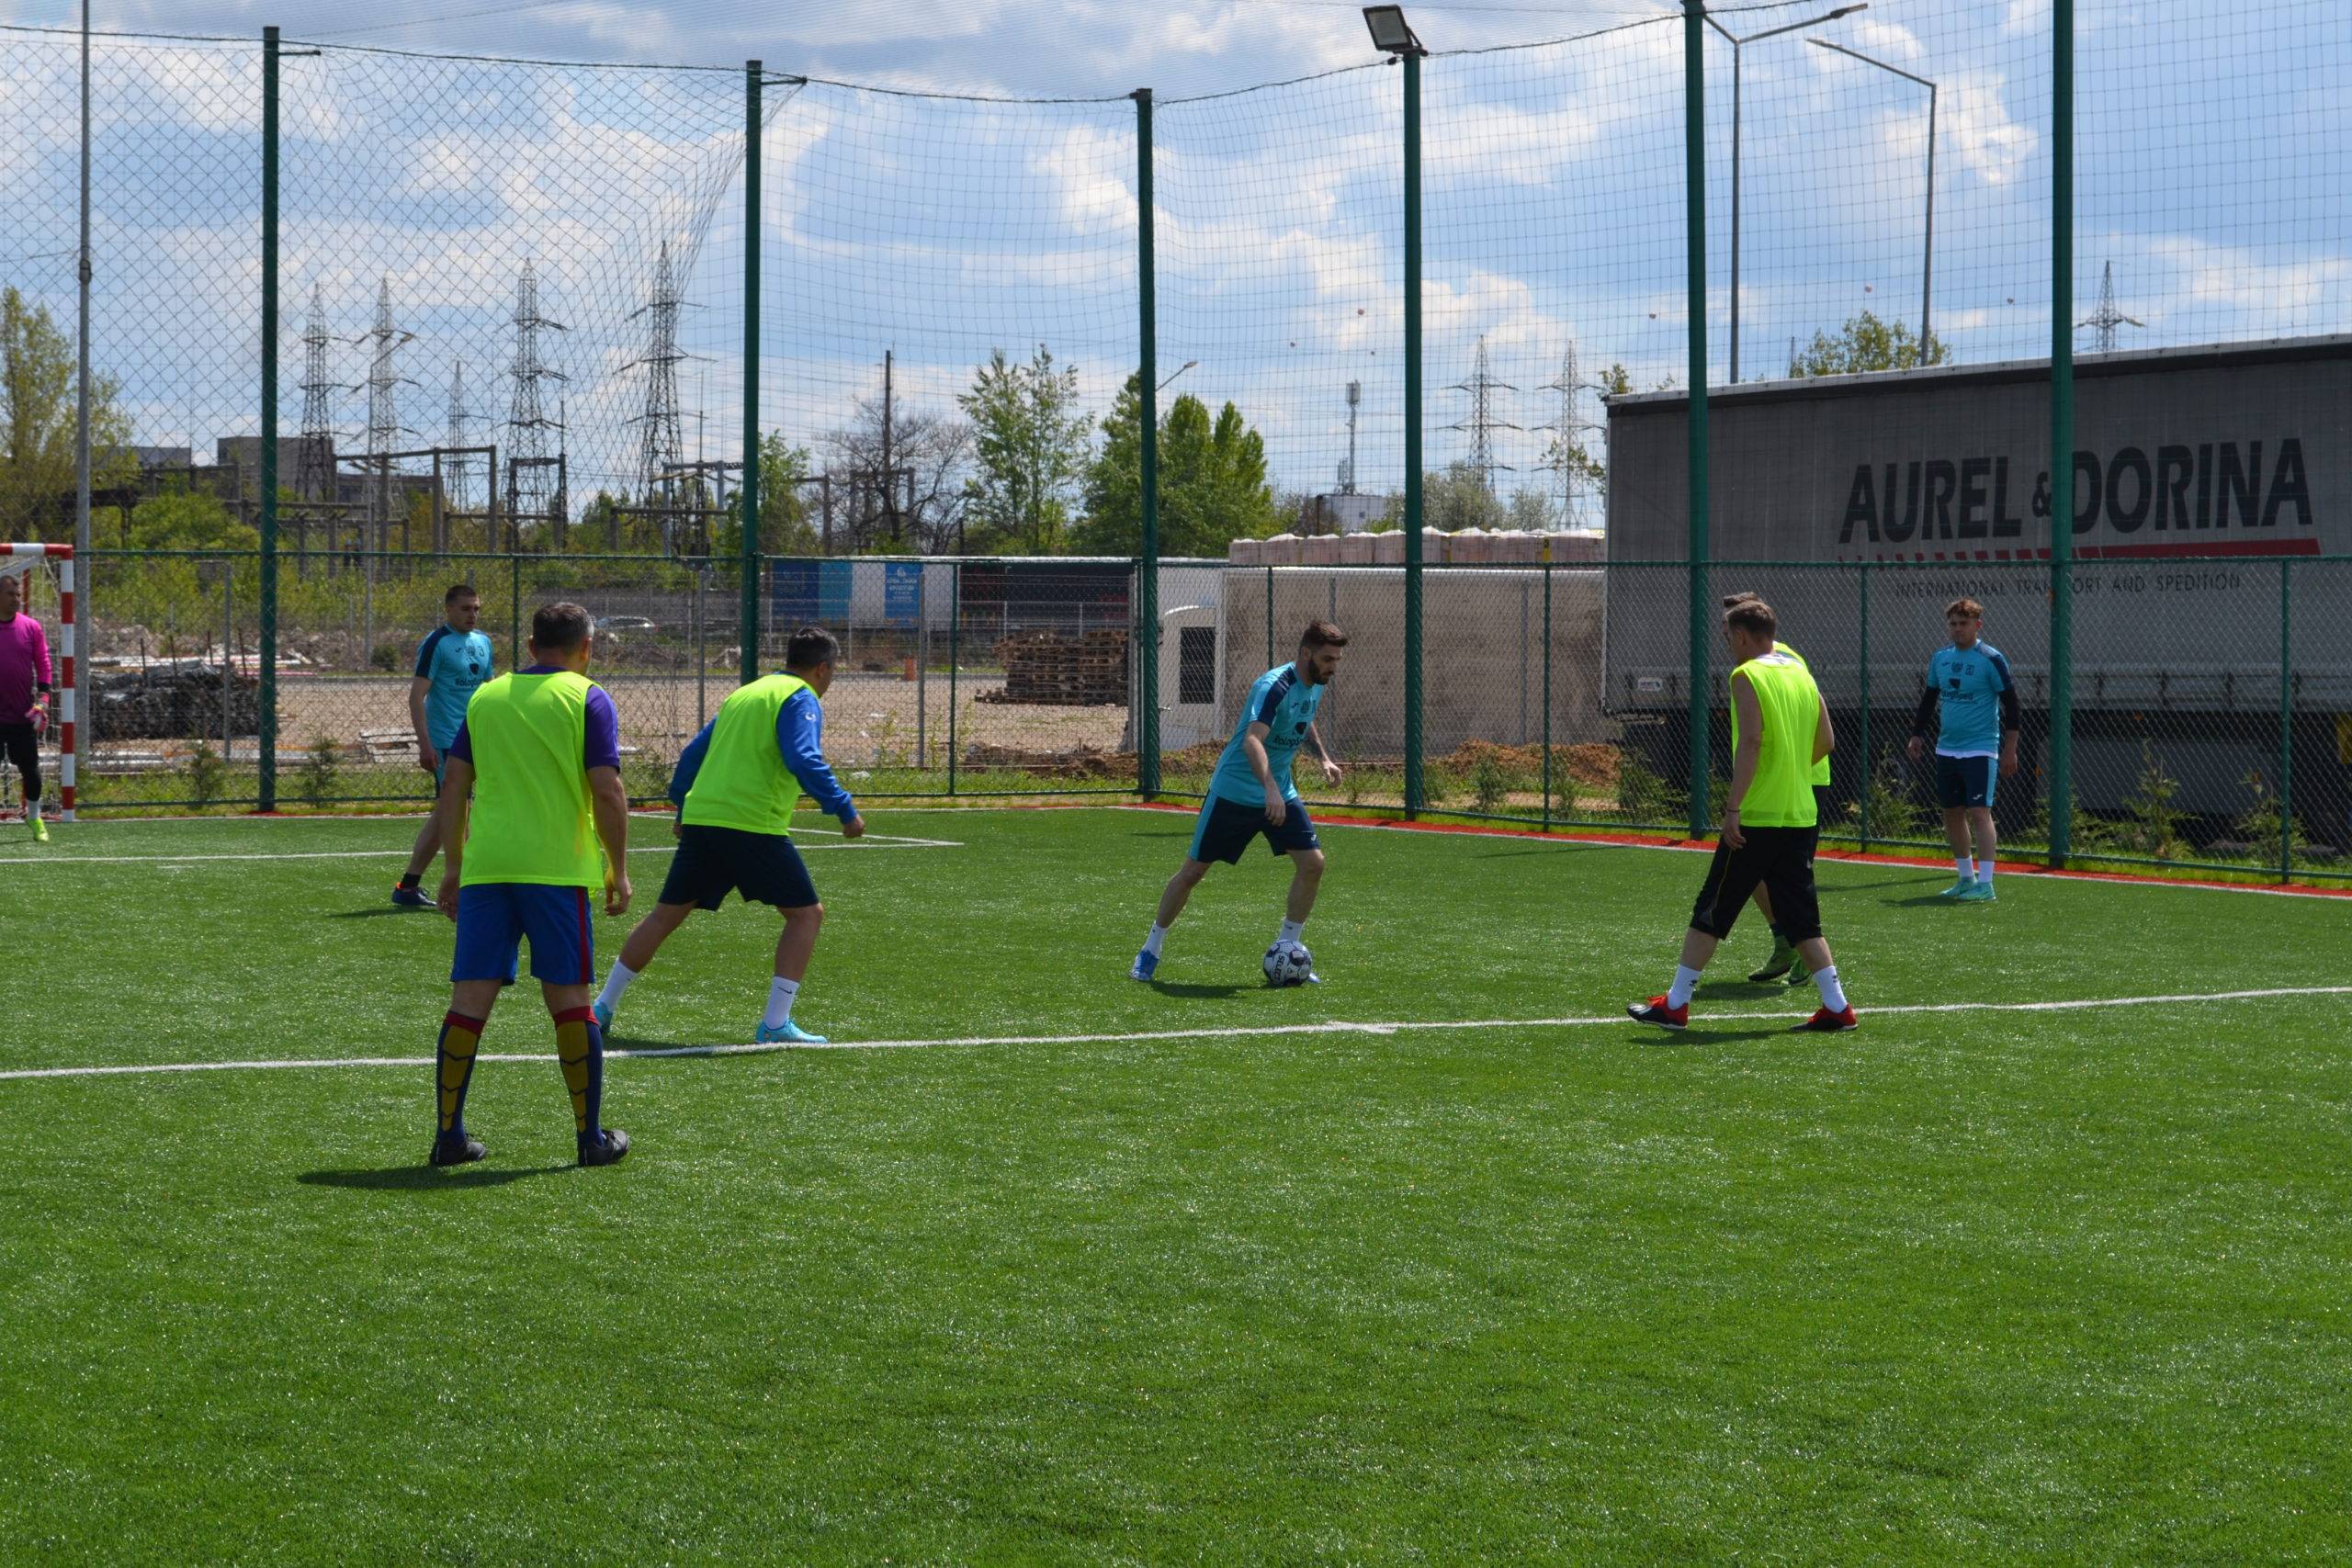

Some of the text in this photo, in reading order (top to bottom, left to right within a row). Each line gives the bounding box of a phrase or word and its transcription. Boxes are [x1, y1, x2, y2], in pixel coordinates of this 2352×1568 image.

[1838, 437, 2313, 544] AUREL & DORINA
[1895, 578, 2007, 598] INTERNATIONAL
[2112, 576, 2145, 593] AND
[2158, 571, 2241, 592] SPEDITION
[479, 646, 485, 657] 3
